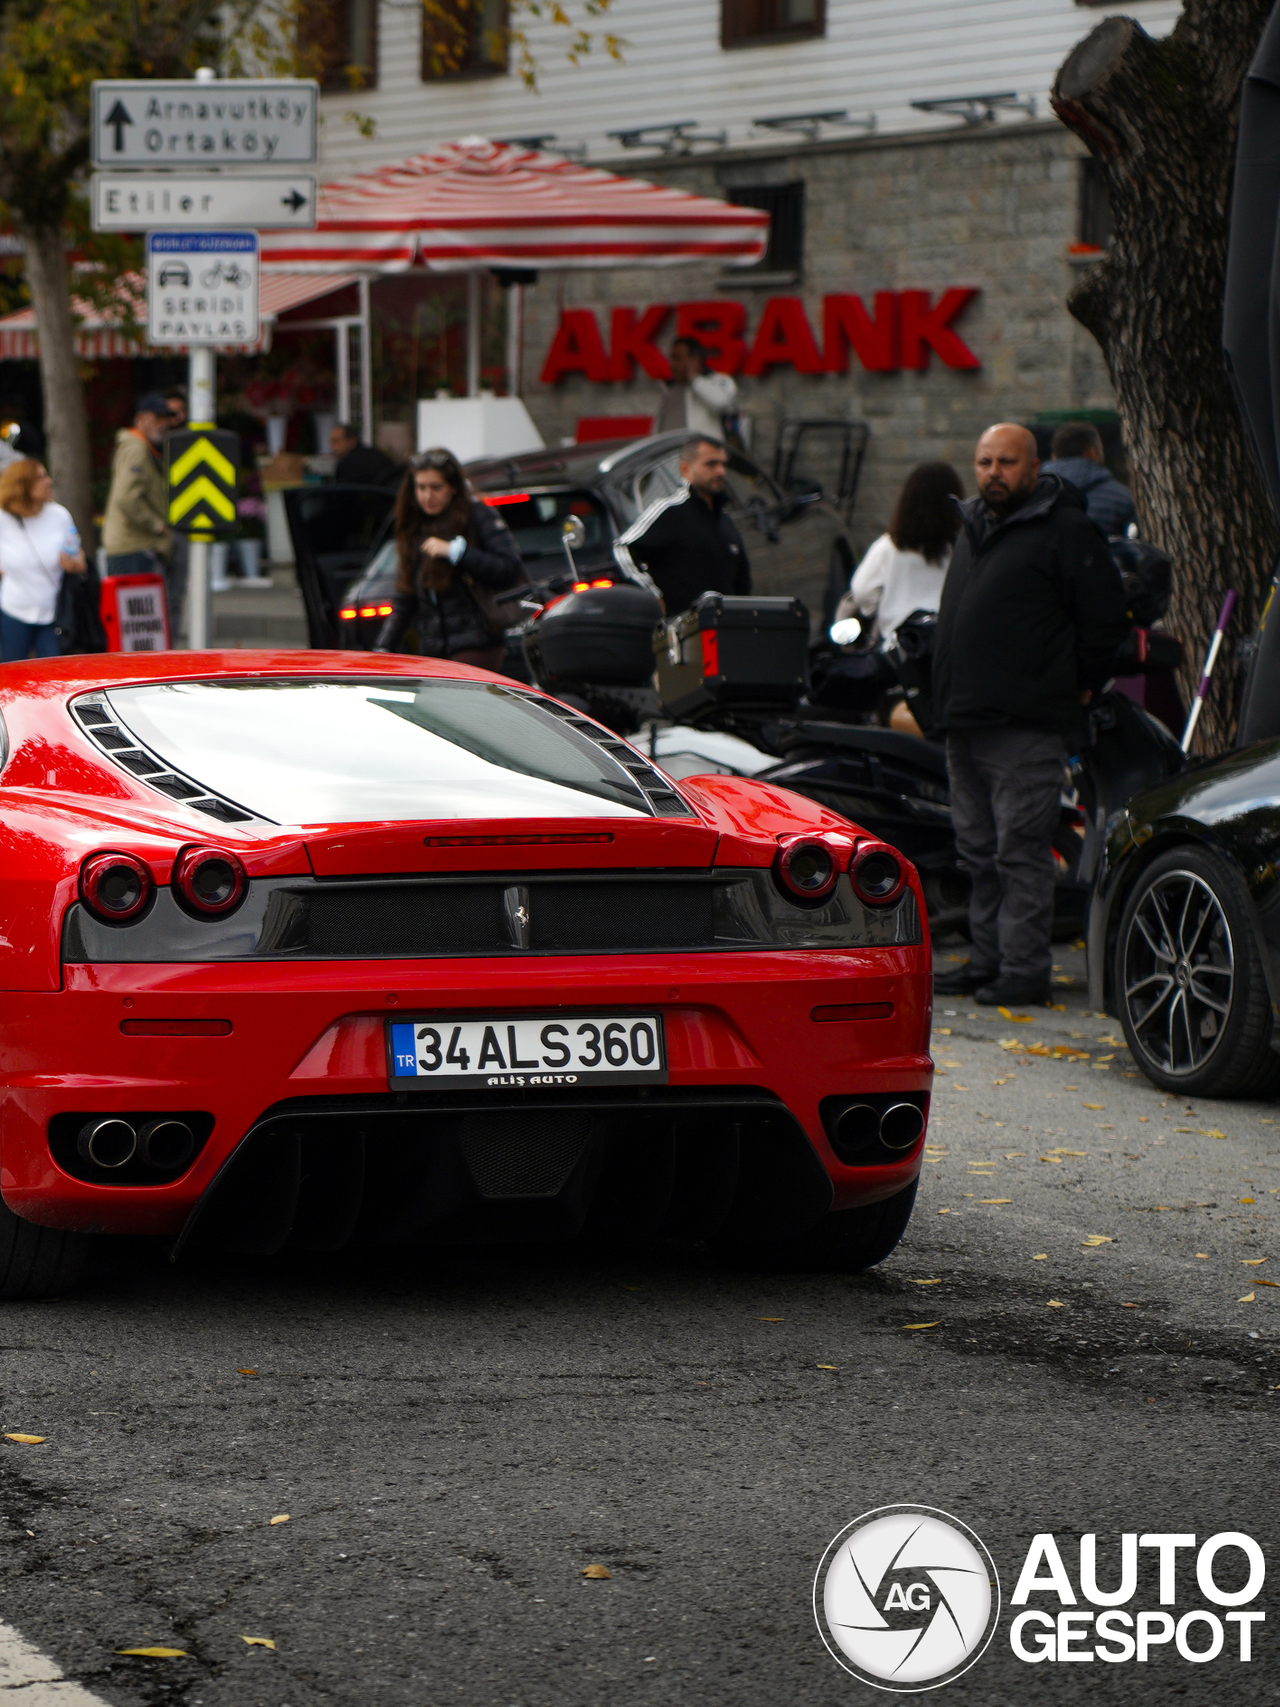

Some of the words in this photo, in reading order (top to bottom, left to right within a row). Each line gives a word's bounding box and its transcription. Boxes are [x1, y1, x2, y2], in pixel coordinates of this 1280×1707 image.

[145, 96, 308, 126] Arnavutköy
[144, 128, 280, 157] Ortaköy
[106, 188, 212, 213] Etiler
[540, 287, 982, 384] AKBANK
[396, 1055, 415, 1067] TR
[530, 1074, 578, 1085] AUTO
